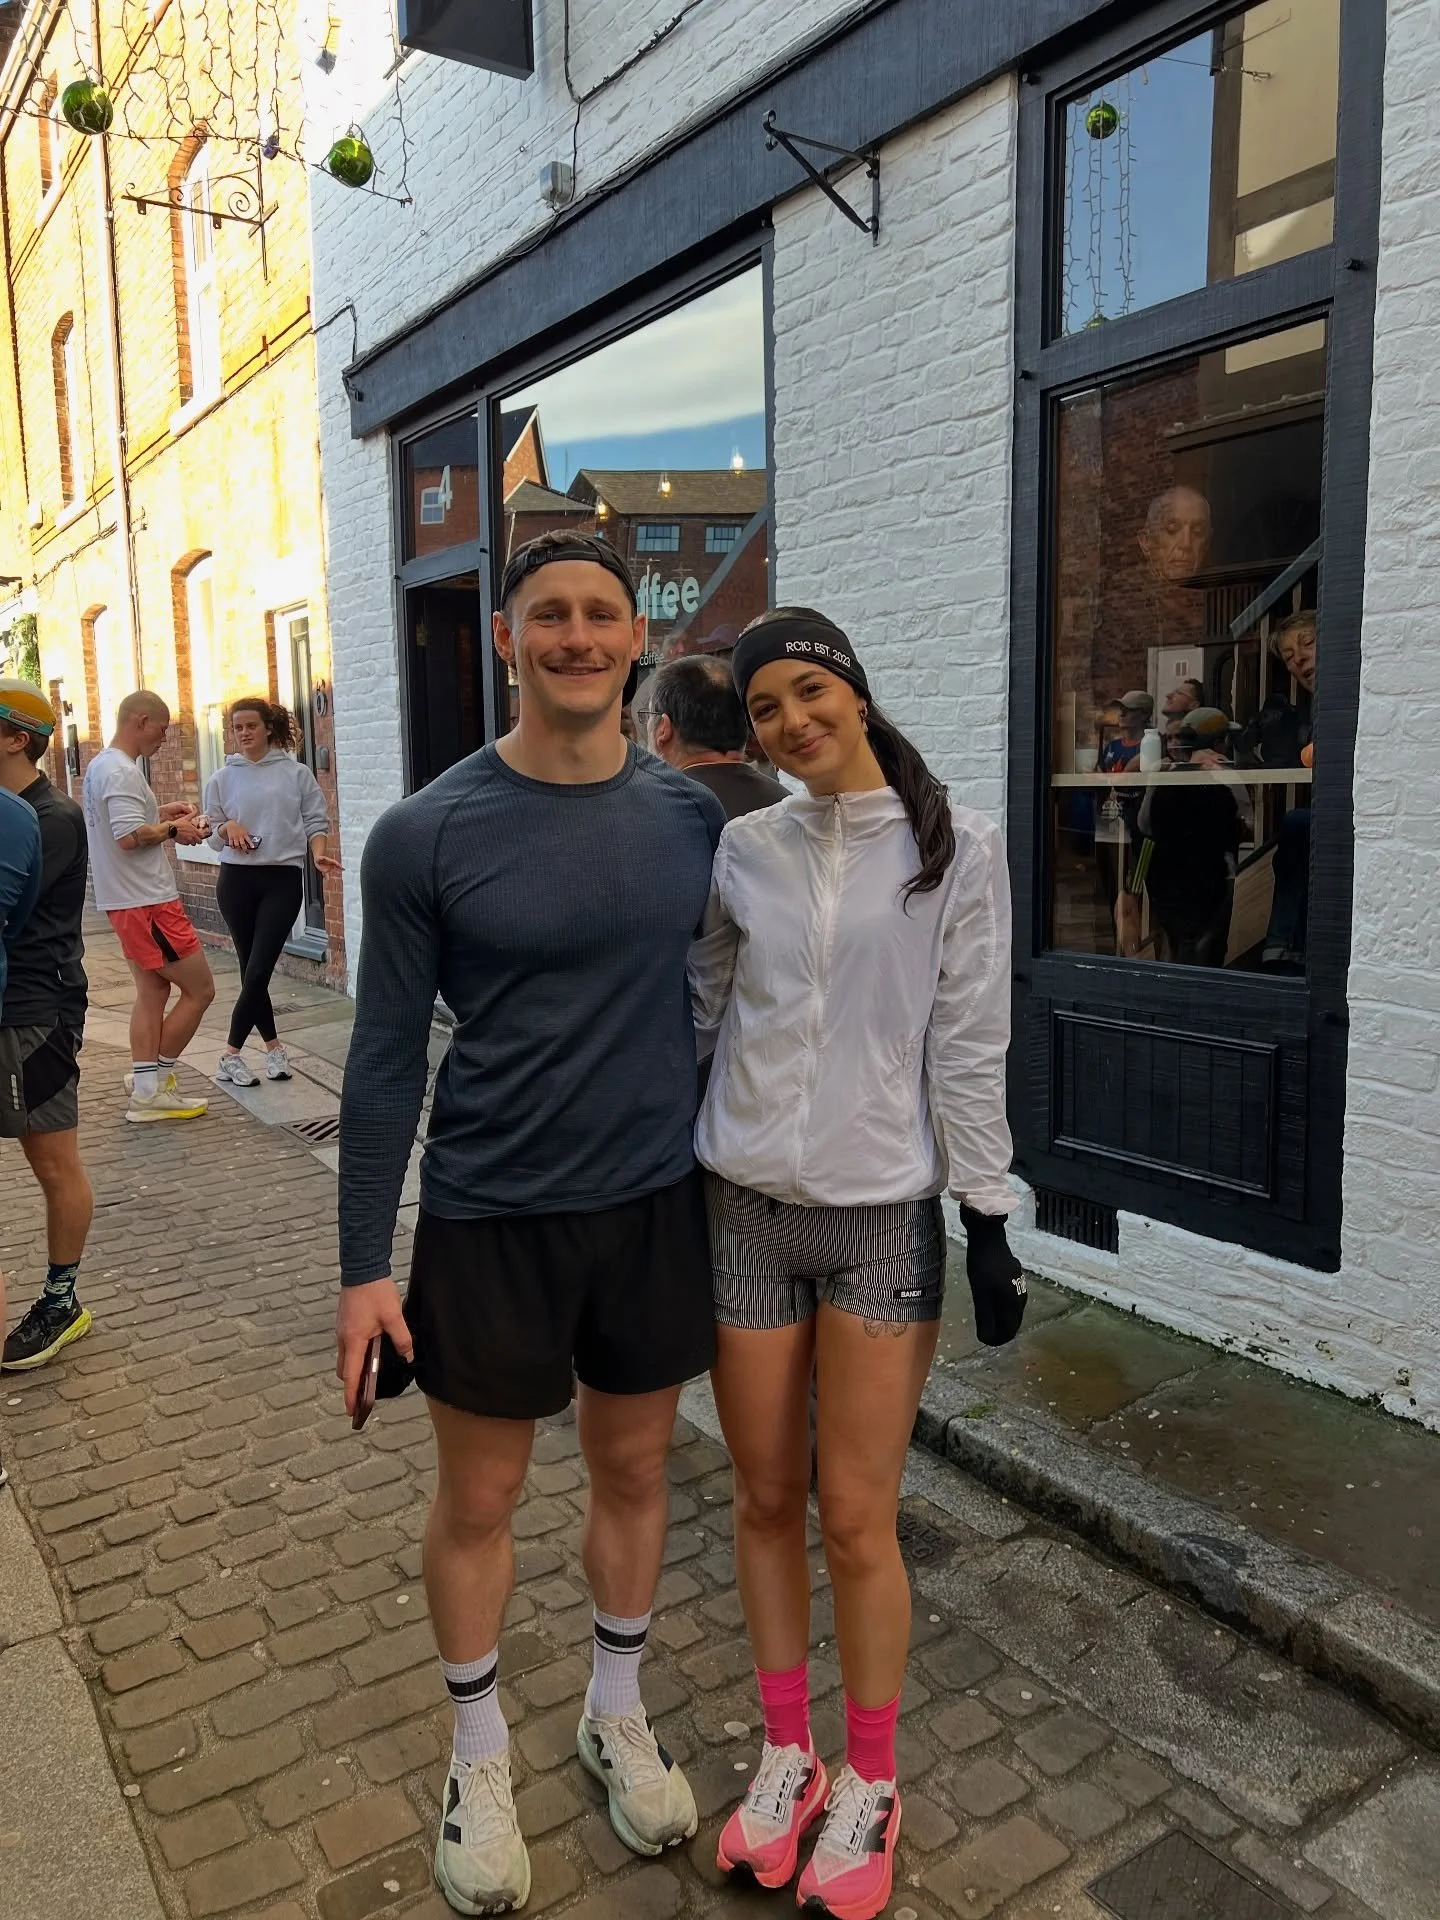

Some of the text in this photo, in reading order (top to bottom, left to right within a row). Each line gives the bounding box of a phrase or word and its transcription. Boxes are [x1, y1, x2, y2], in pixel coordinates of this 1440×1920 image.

[438, 465, 453, 510] 4
[637, 572, 700, 619] ffee
[785, 641, 811, 653] RCIC
[814, 642, 831, 657] EST.
[639, 652, 665, 666] coffee
[900, 1290, 922, 1298] BANDIT
